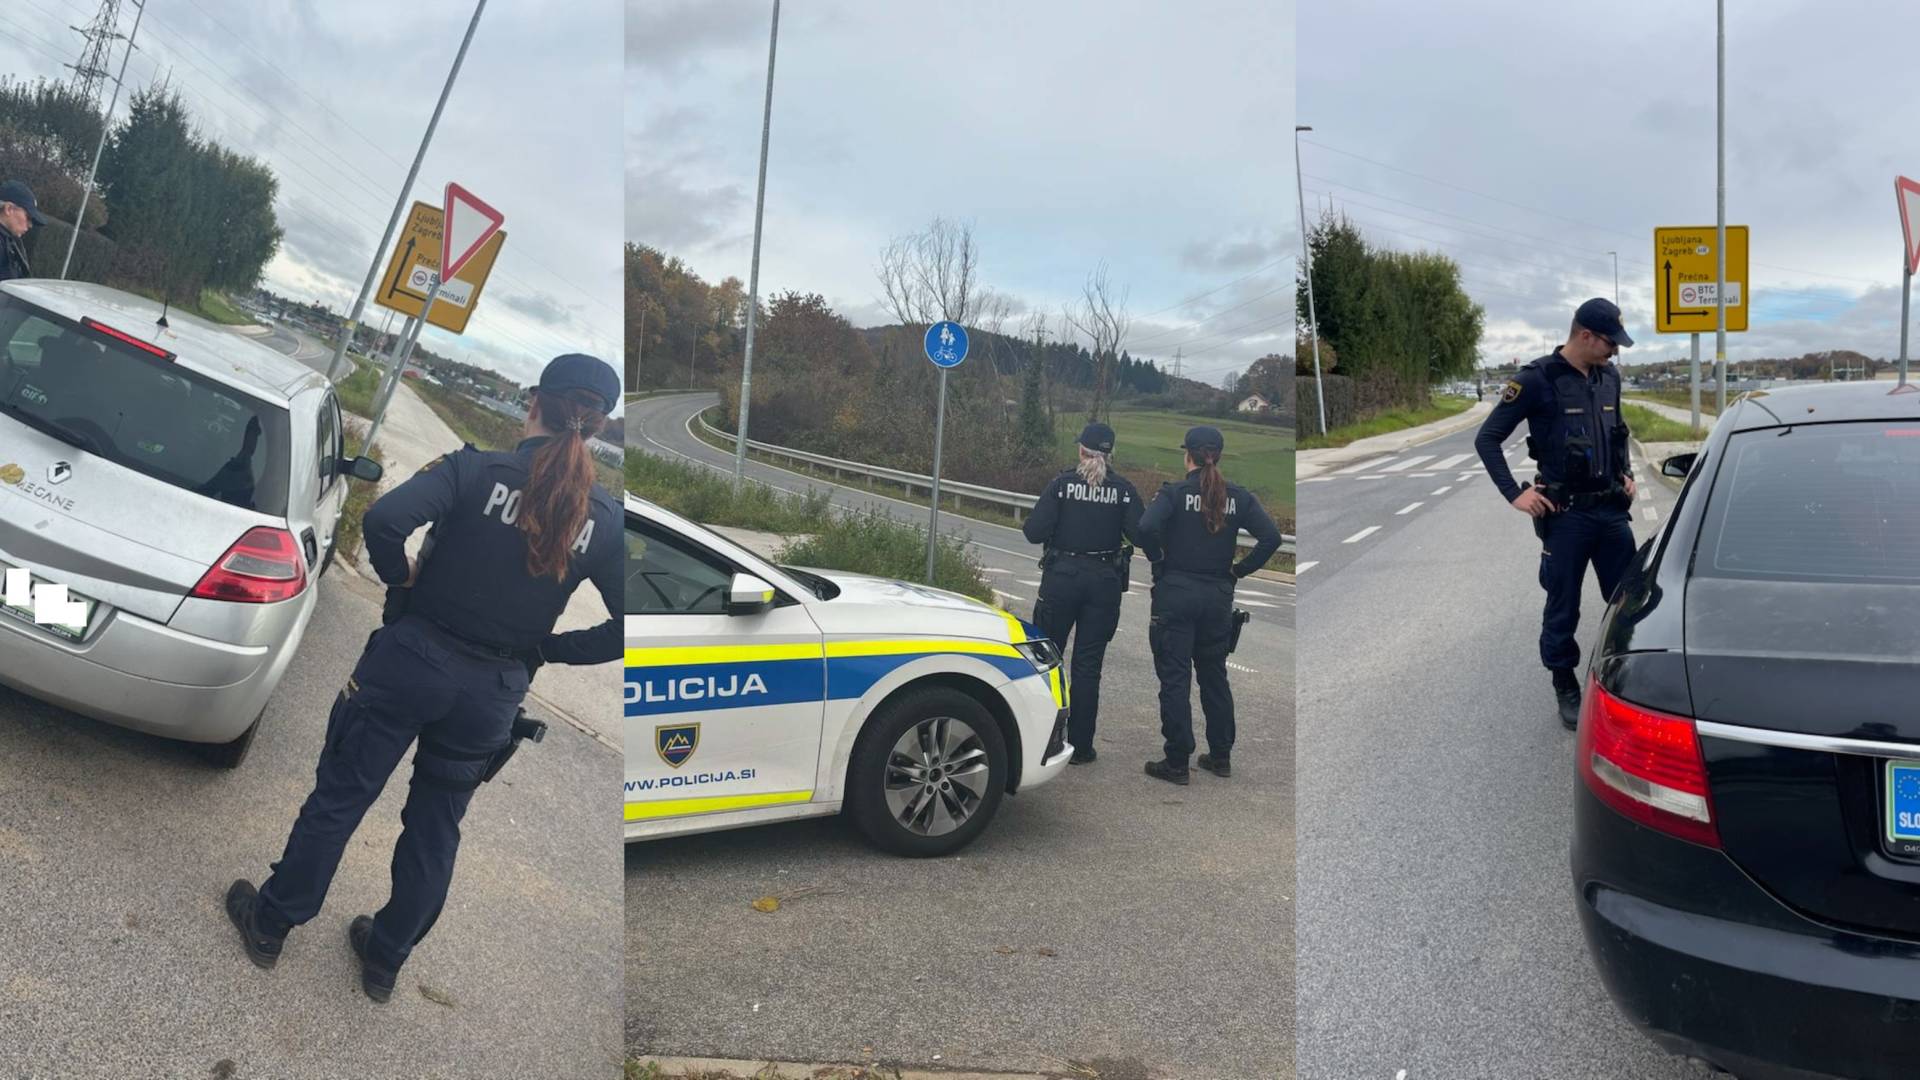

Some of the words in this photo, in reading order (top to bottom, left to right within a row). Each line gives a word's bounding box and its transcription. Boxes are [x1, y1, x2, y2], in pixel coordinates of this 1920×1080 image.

[1661, 236, 1703, 245] Ljubljana
[1662, 246, 1694, 256] Zagreb
[426, 283, 467, 305] Trminali
[1697, 285, 1715, 295] BTC
[1697, 296, 1739, 305] Termali
[1066, 483, 1118, 505] POLICIJA
[1185, 494, 1237, 515] POJA
[624, 673, 768, 704] OLICIJA
